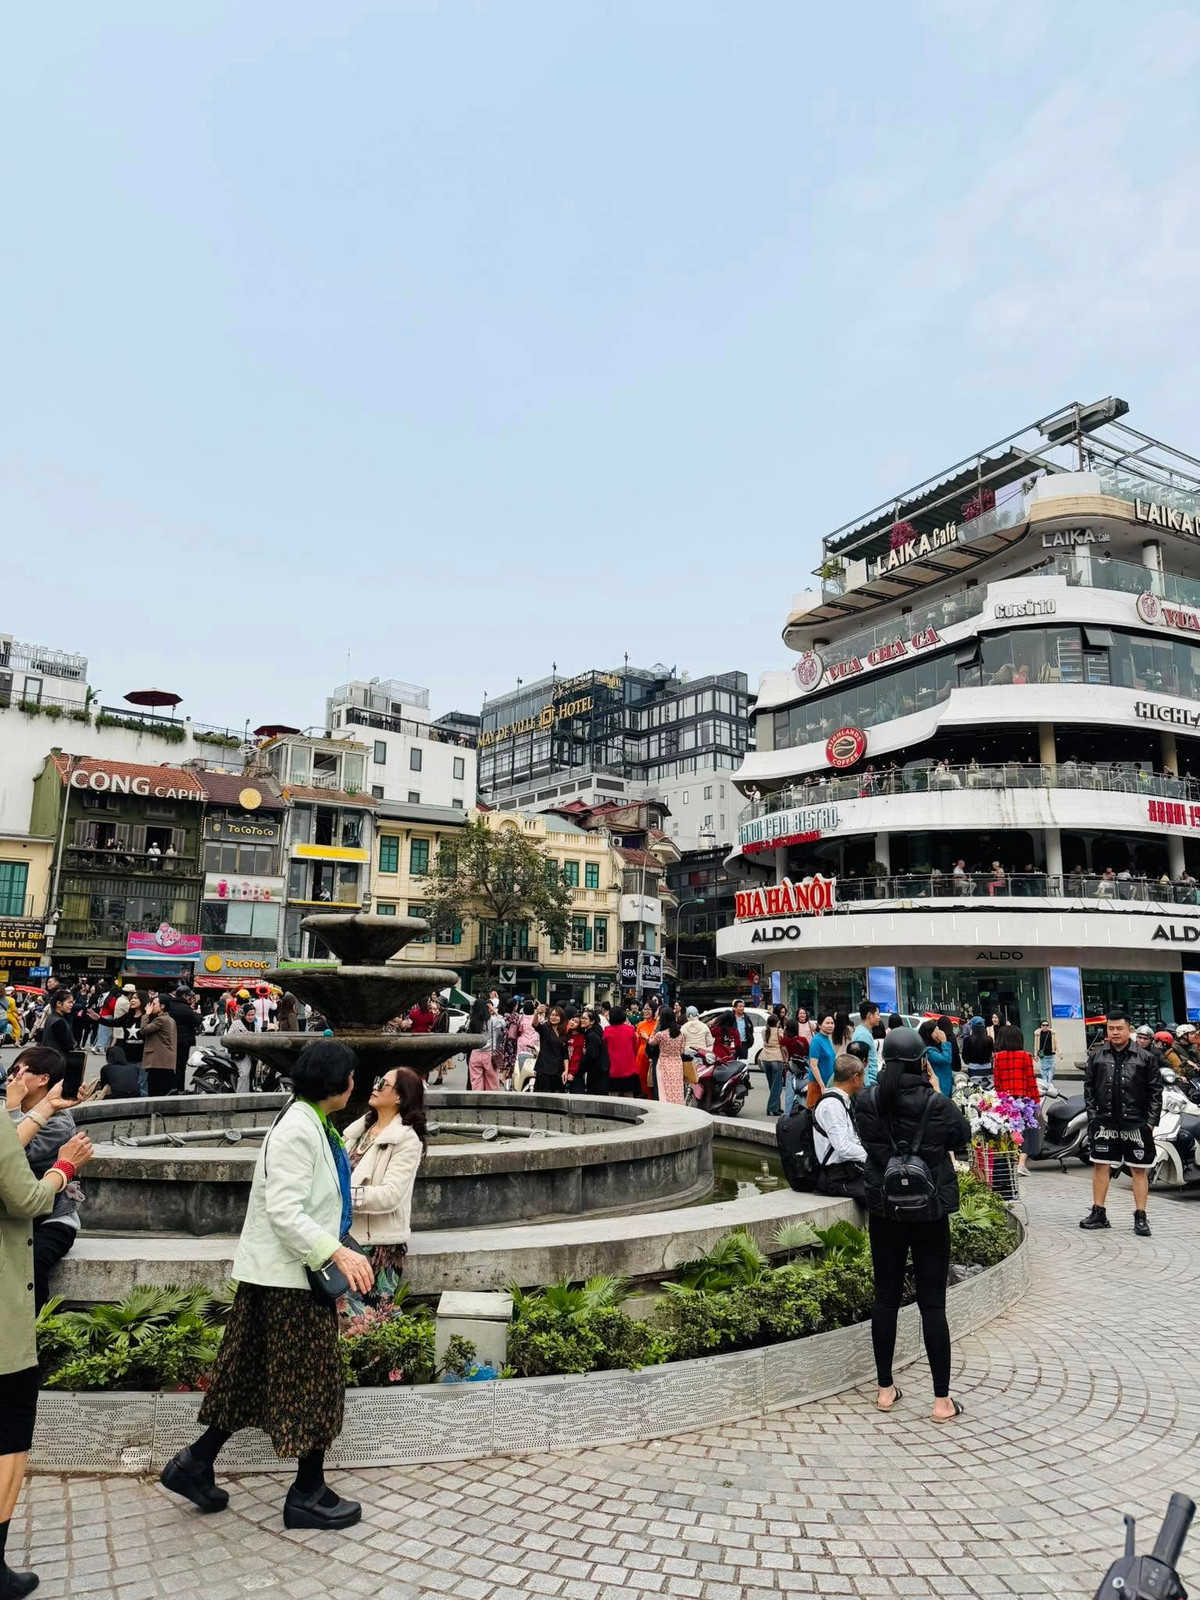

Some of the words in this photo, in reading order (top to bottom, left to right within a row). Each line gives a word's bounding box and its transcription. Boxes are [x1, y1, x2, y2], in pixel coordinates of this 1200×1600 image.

[1135, 498, 1194, 534] LAIKA
[877, 534, 931, 575] LAIKA
[933, 520, 957, 548] Café
[1042, 528, 1096, 548] LAIKA
[1161, 608, 1200, 632] VUA
[828, 656, 863, 680] VUA
[911, 624, 941, 650] CÁ
[478, 729, 496, 748] MAY
[497, 724, 509, 742] DE
[511, 714, 536, 737] VILLE
[559, 696, 593, 720] HOTEL
[1134, 701, 1200, 728] HIGHL
[828, 729, 862, 750] HIGHLANDS
[832, 752, 859, 766] COFFEE
[764, 814, 788, 837] 1930
[793, 806, 838, 832] BISTRO
[736, 892, 764, 918] BIA
[766, 880, 794, 915] HÀ
[794, 876, 833, 917] NỘI
[8, 929, 26, 941] CỘT
[751, 925, 800, 943] ALDO
[1151, 924, 1200, 941] ALD
[18, 939, 38, 951] HIỆU
[624, 958, 635, 966] FS
[976, 951, 1023, 960] ALDO
[622, 968, 638, 978] SPA
